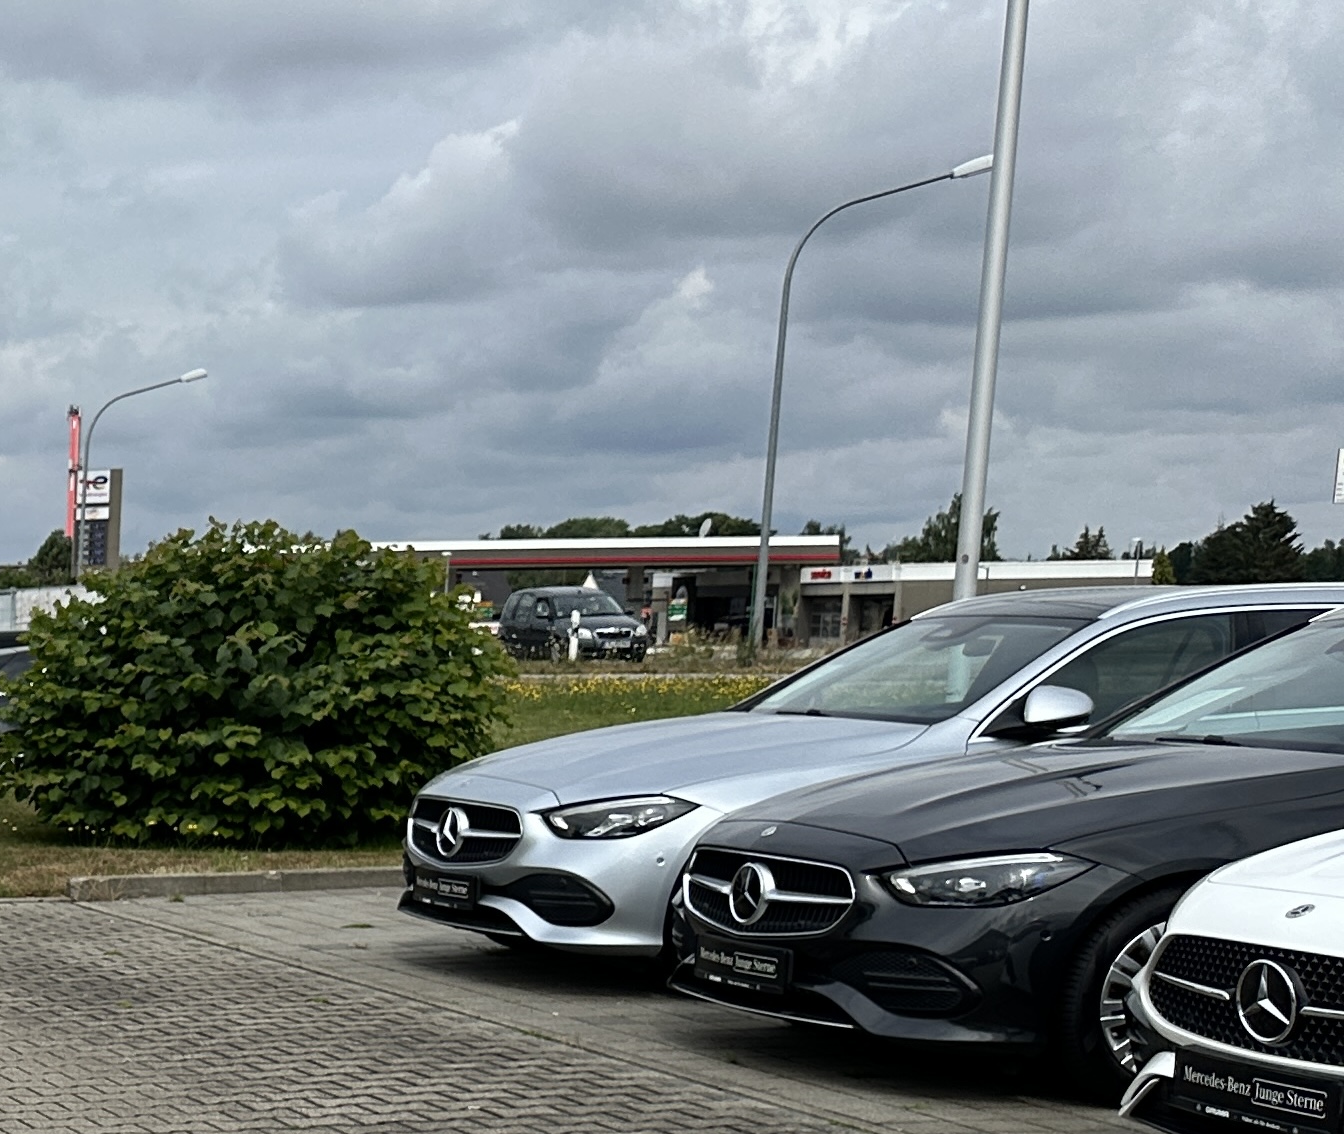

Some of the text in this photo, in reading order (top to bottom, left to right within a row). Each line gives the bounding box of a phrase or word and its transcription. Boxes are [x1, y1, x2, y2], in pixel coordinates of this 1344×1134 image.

[1184, 1065, 1324, 1112] Mercedes-Benz Junge Sterne
